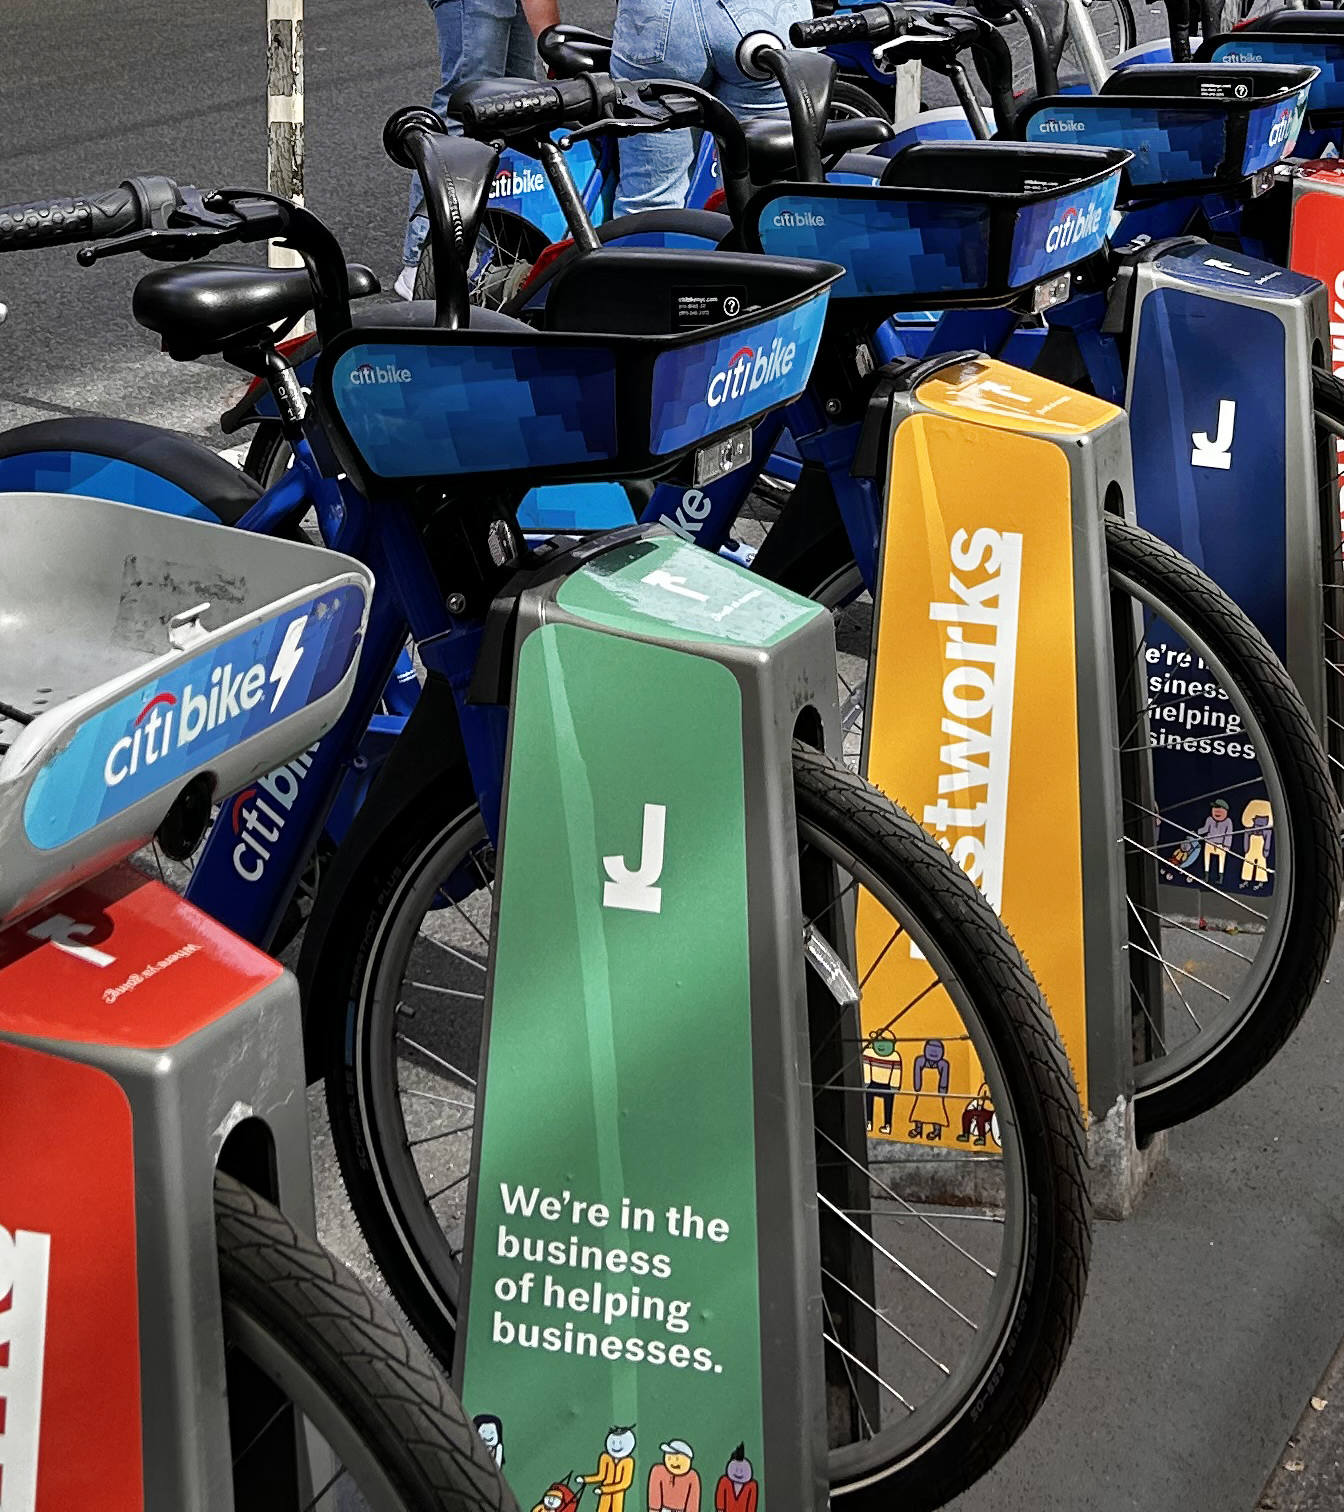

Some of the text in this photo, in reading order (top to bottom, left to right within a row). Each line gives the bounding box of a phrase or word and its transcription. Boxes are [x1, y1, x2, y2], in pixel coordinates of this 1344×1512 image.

[1145, 643, 1192, 668] e're
[378, 866, 402, 906] PLUS
[500, 1182, 730, 1242] We're in the
[497, 1225, 672, 1278] business
[494, 1272, 692, 1334] of helping
[492, 1311, 723, 1373] businesses.
